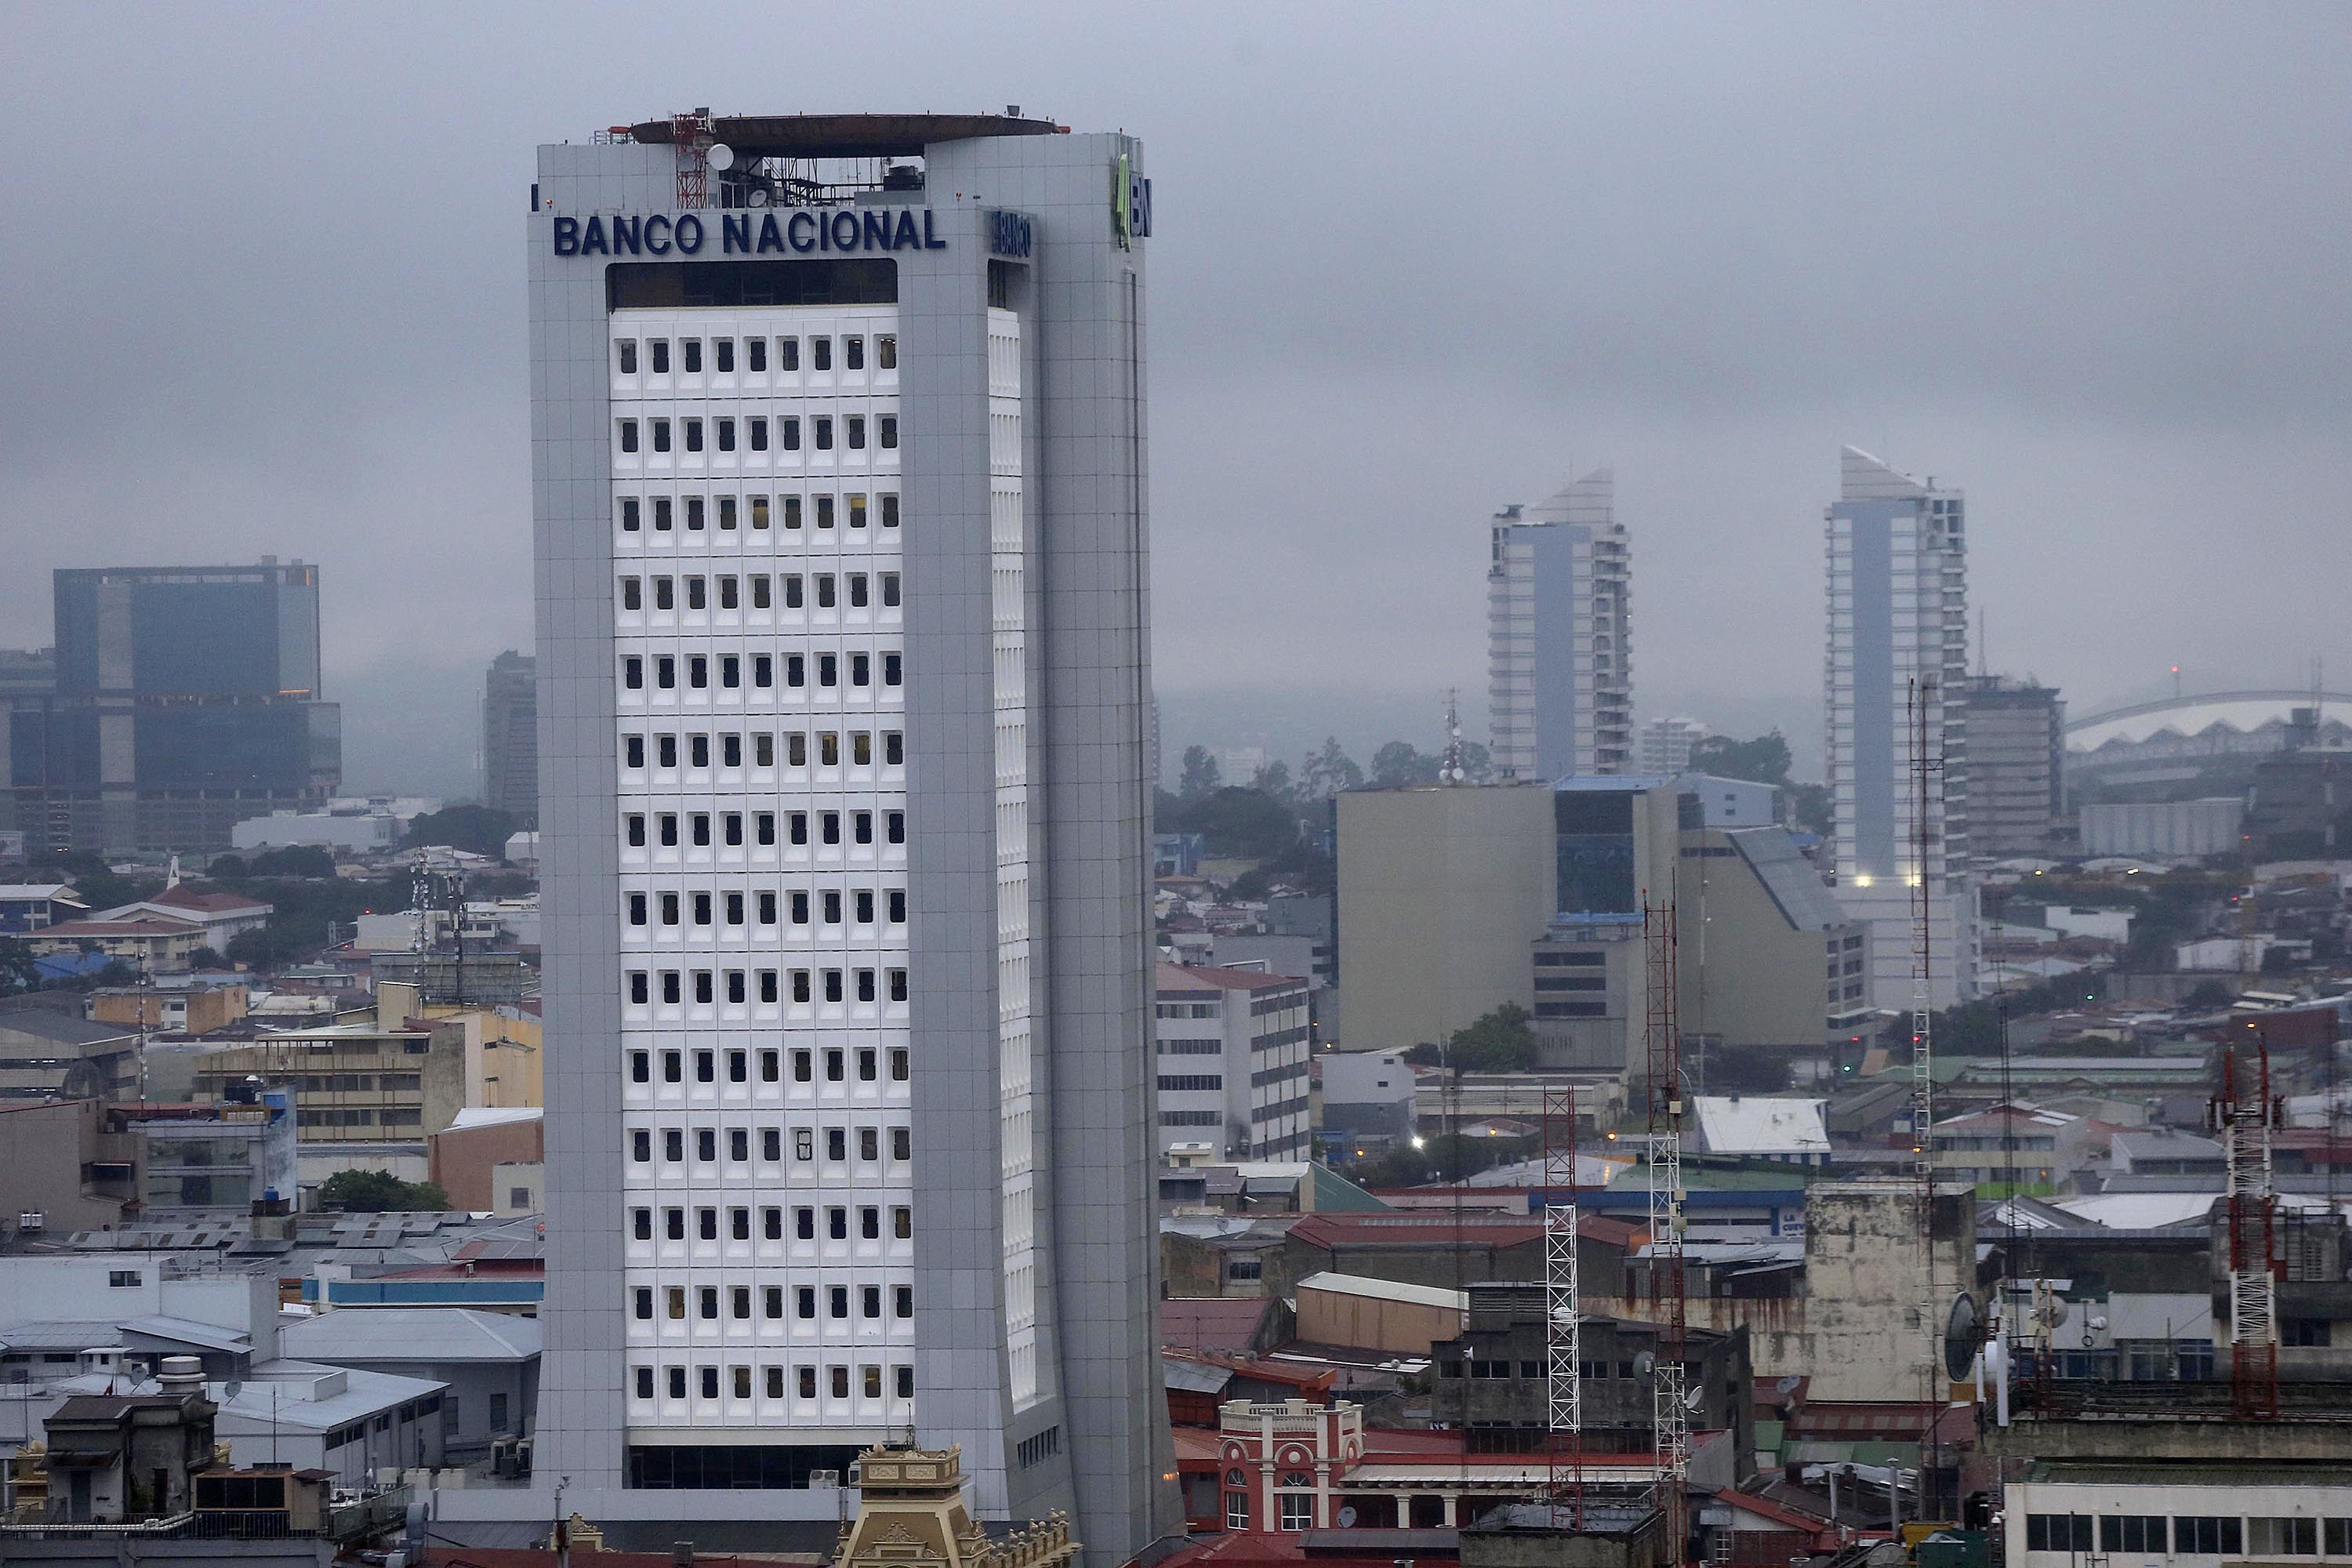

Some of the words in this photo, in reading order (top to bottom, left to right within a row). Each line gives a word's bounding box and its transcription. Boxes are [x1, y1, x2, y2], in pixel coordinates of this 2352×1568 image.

[1129, 173, 1152, 238] BN
[554, 214, 704, 256] BANCO
[722, 211, 946, 253] NACIONAL
